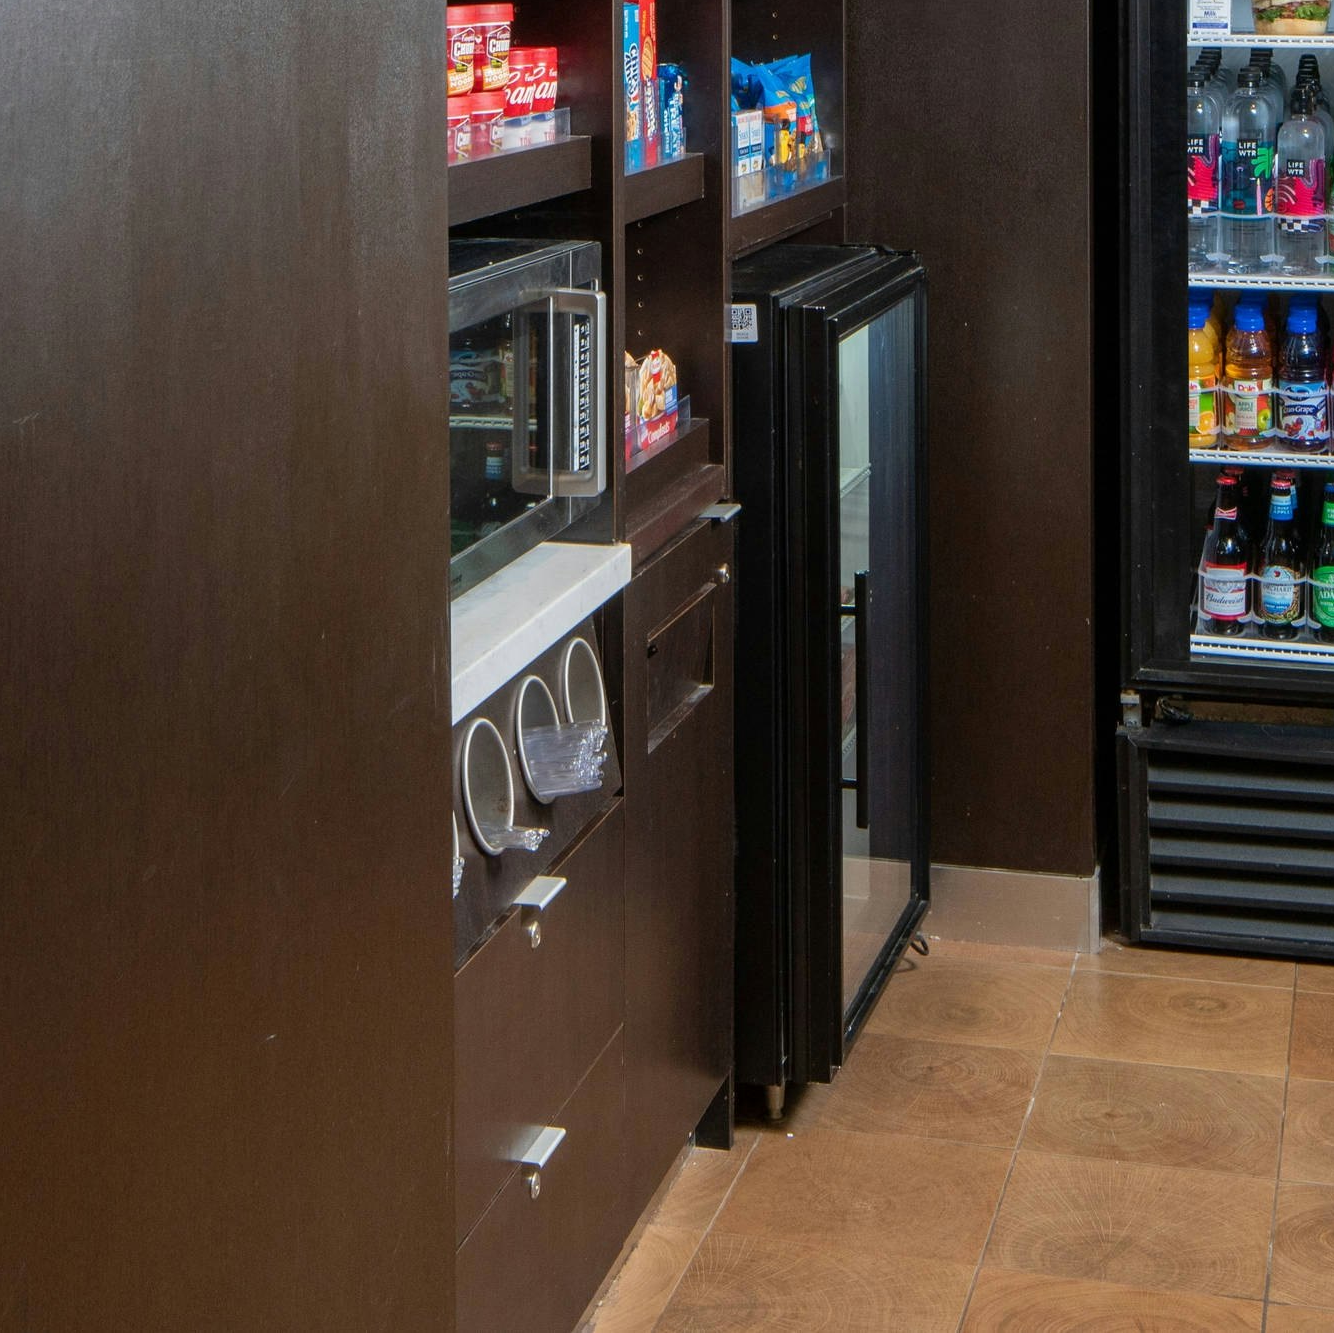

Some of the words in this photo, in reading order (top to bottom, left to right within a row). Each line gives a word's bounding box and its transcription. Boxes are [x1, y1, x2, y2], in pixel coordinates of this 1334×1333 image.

[1288, 161, 1304, 169] LIFE
[1238, 384, 1256, 392] Dole
[1205, 592, 1244, 604] Budweiser
